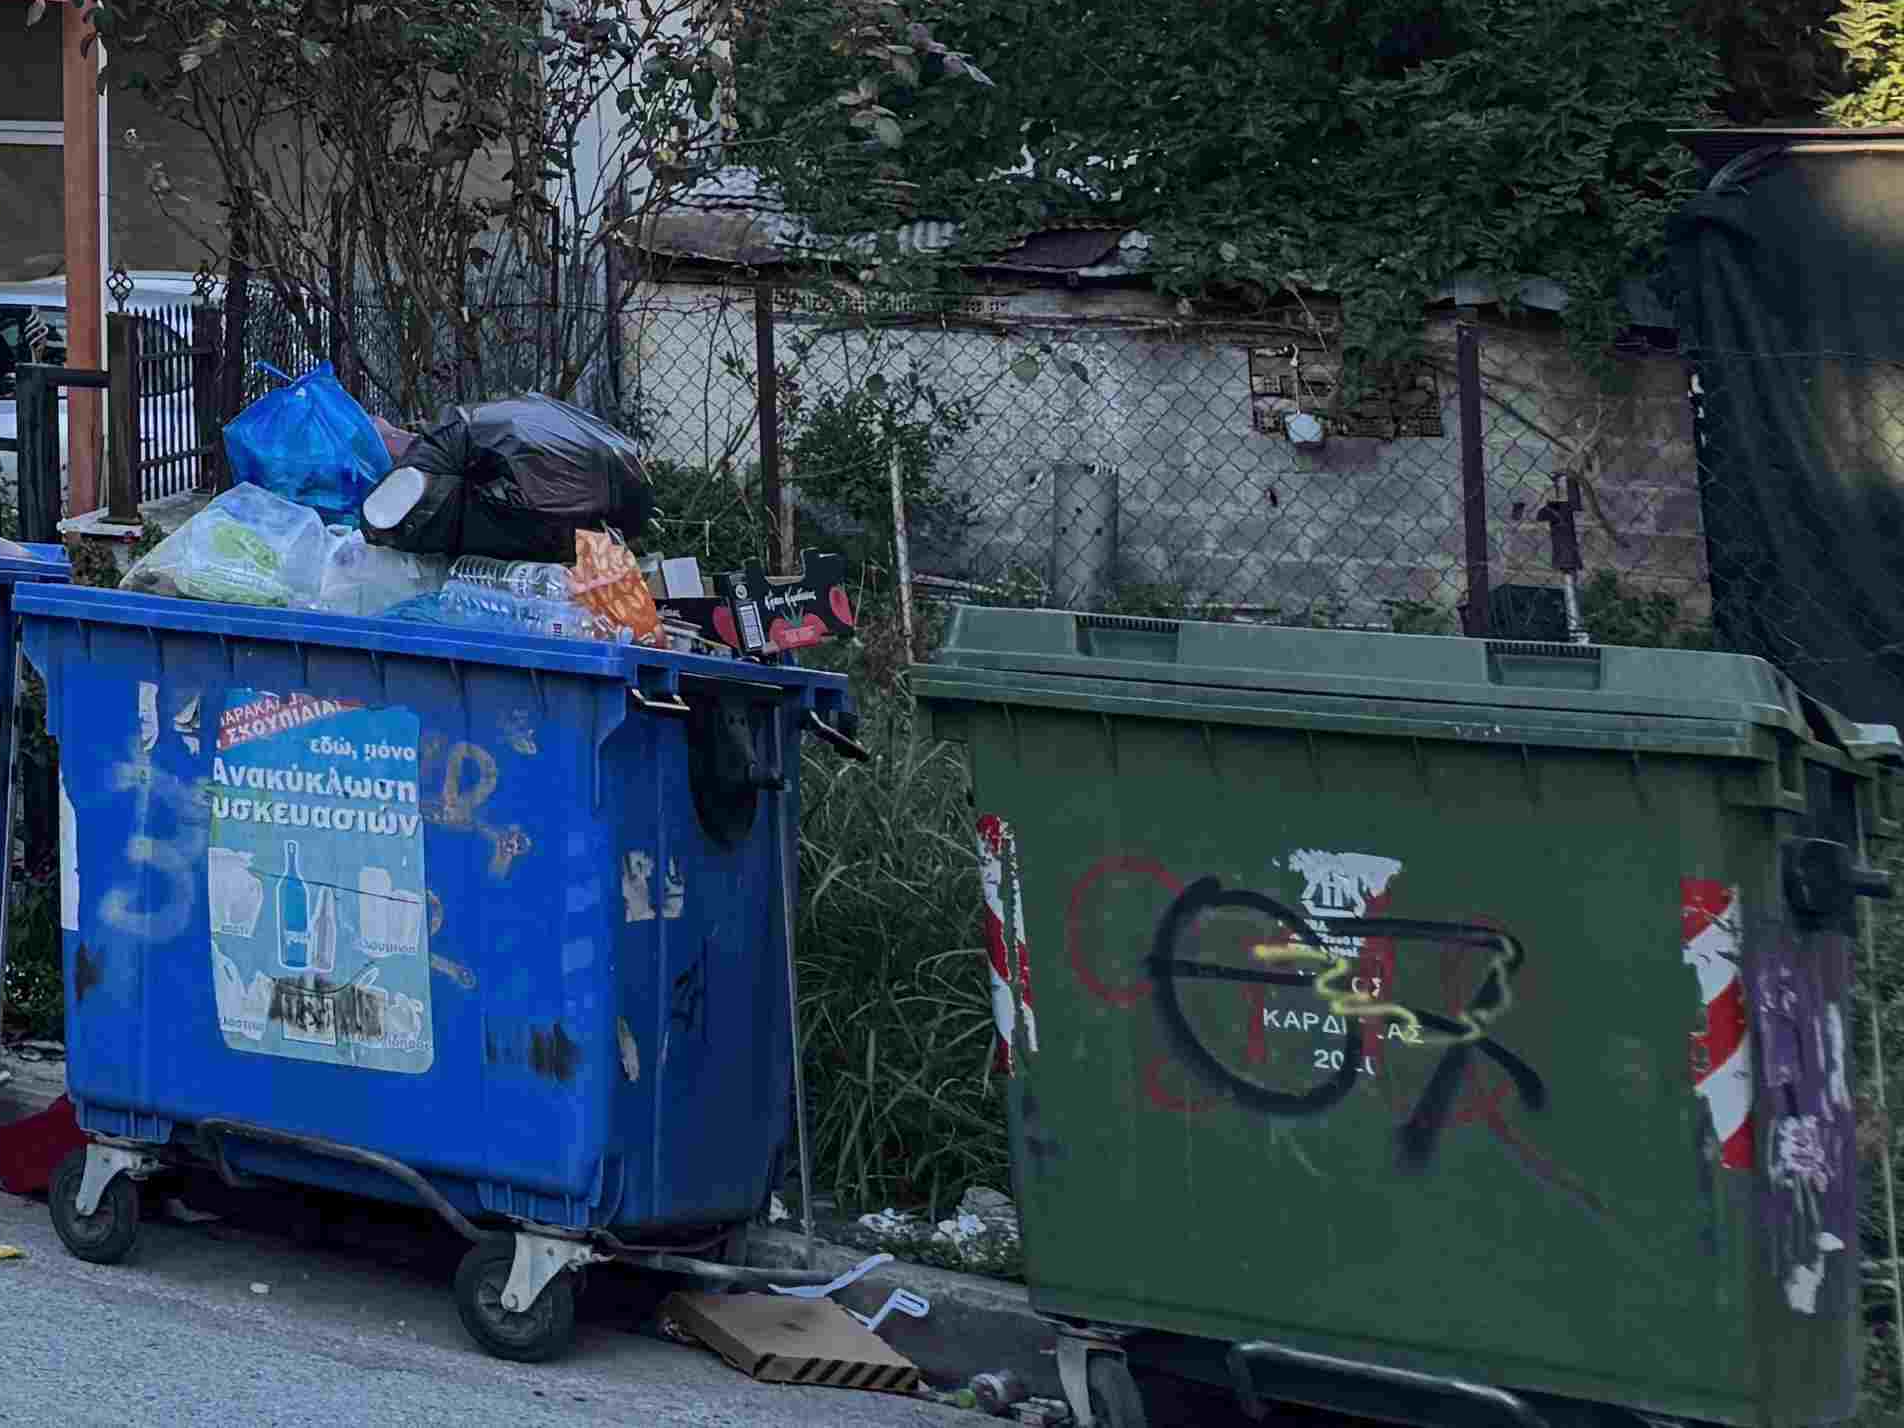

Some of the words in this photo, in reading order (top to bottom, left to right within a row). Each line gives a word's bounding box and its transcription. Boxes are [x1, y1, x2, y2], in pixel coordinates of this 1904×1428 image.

[212, 756, 417, 804] Ανακύκλωση
[212, 794, 420, 838] υσκευασιών
[1262, 1007, 1425, 1044] ΚΑΡΔΙΑΣ
